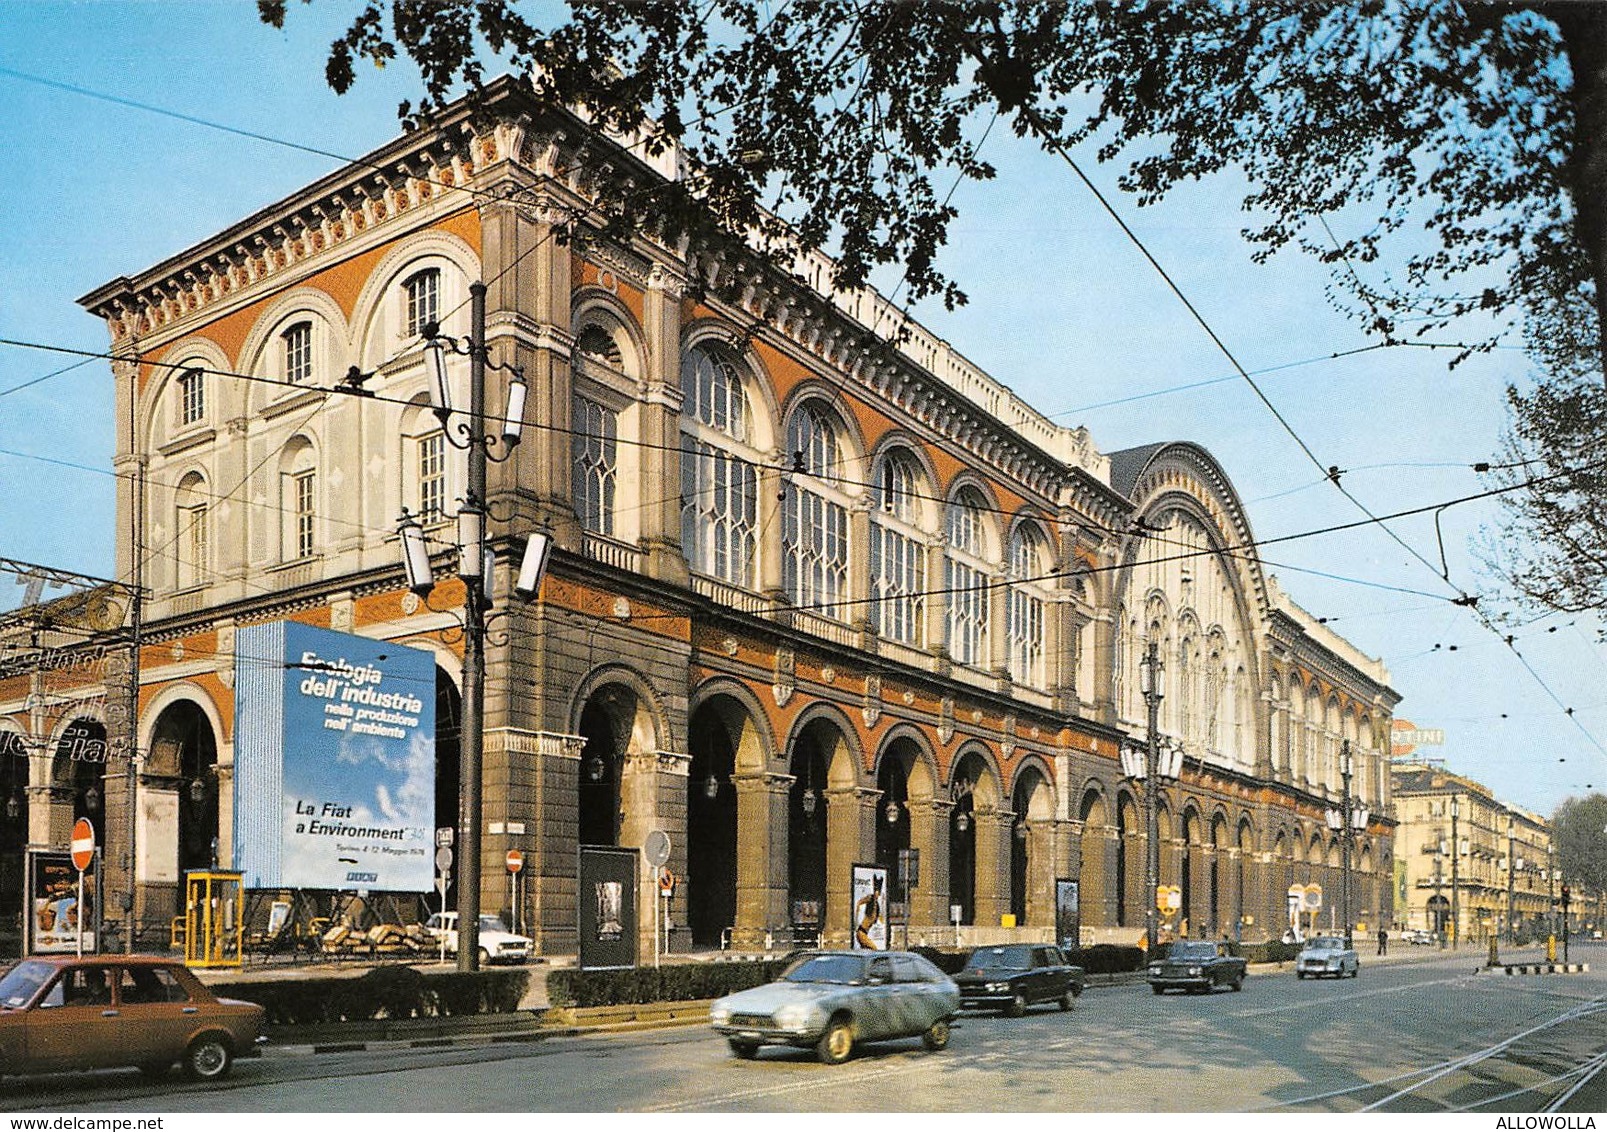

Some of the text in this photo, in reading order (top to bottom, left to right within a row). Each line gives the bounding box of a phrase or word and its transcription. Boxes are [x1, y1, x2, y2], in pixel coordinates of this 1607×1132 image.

[301, 651, 383, 685] Ecologia
[324, 703, 419, 727] nella produzione
[296, 800, 352, 818] La Fiat
[296, 823, 305, 834] a
